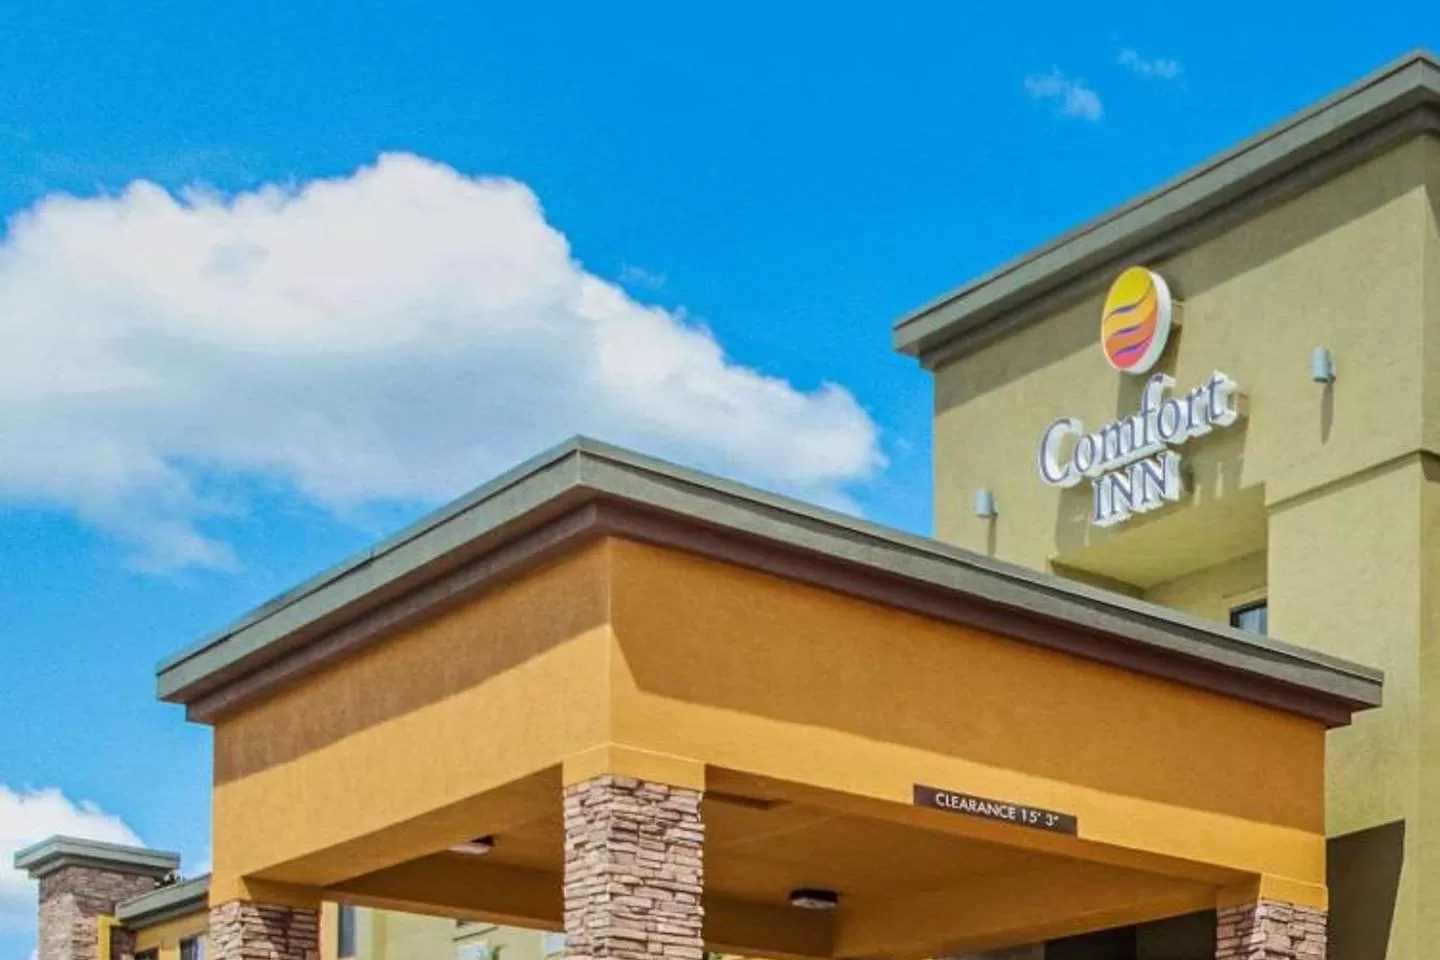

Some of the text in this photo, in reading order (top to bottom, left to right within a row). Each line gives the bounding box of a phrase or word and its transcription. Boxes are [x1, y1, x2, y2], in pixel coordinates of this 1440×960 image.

[1040, 371, 1237, 487] Comfort
[1092, 450, 1181, 527] INN
[935, 792, 1017, 820] CLEARANCE
